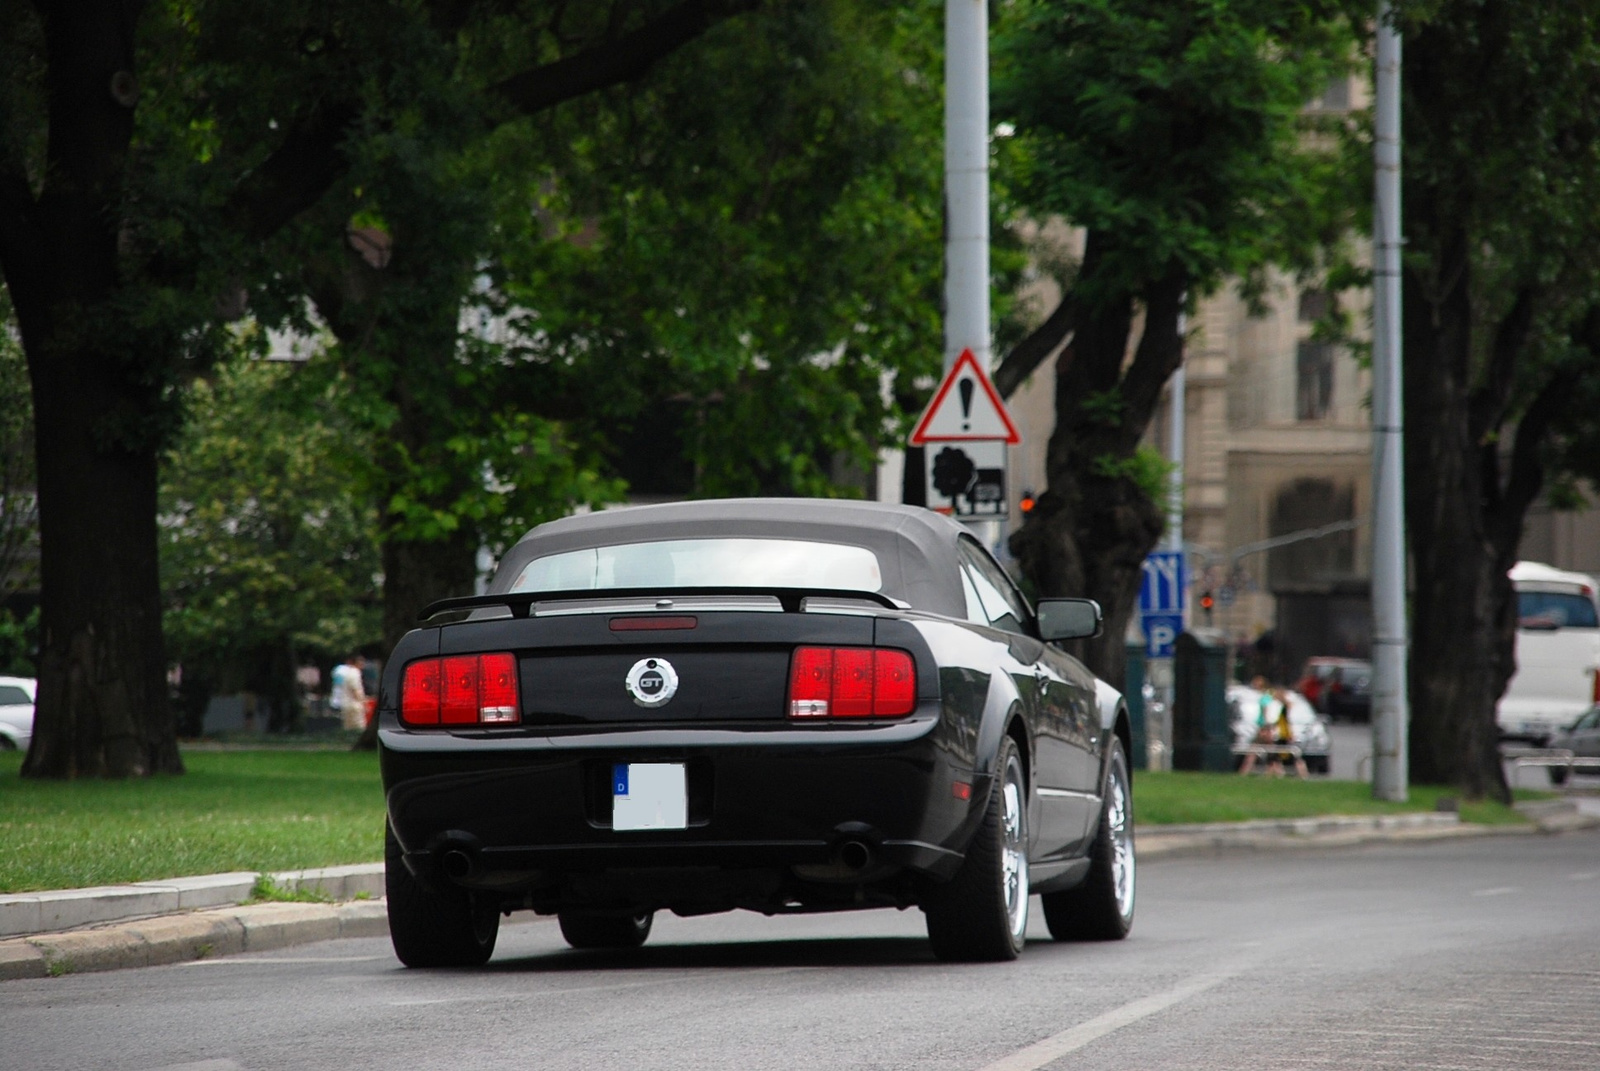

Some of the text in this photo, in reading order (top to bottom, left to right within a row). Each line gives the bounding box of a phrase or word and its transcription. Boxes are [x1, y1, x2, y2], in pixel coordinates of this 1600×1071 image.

[1151, 626, 1175, 656] P
[641, 677, 662, 687] GT
[618, 783, 625, 792] D
